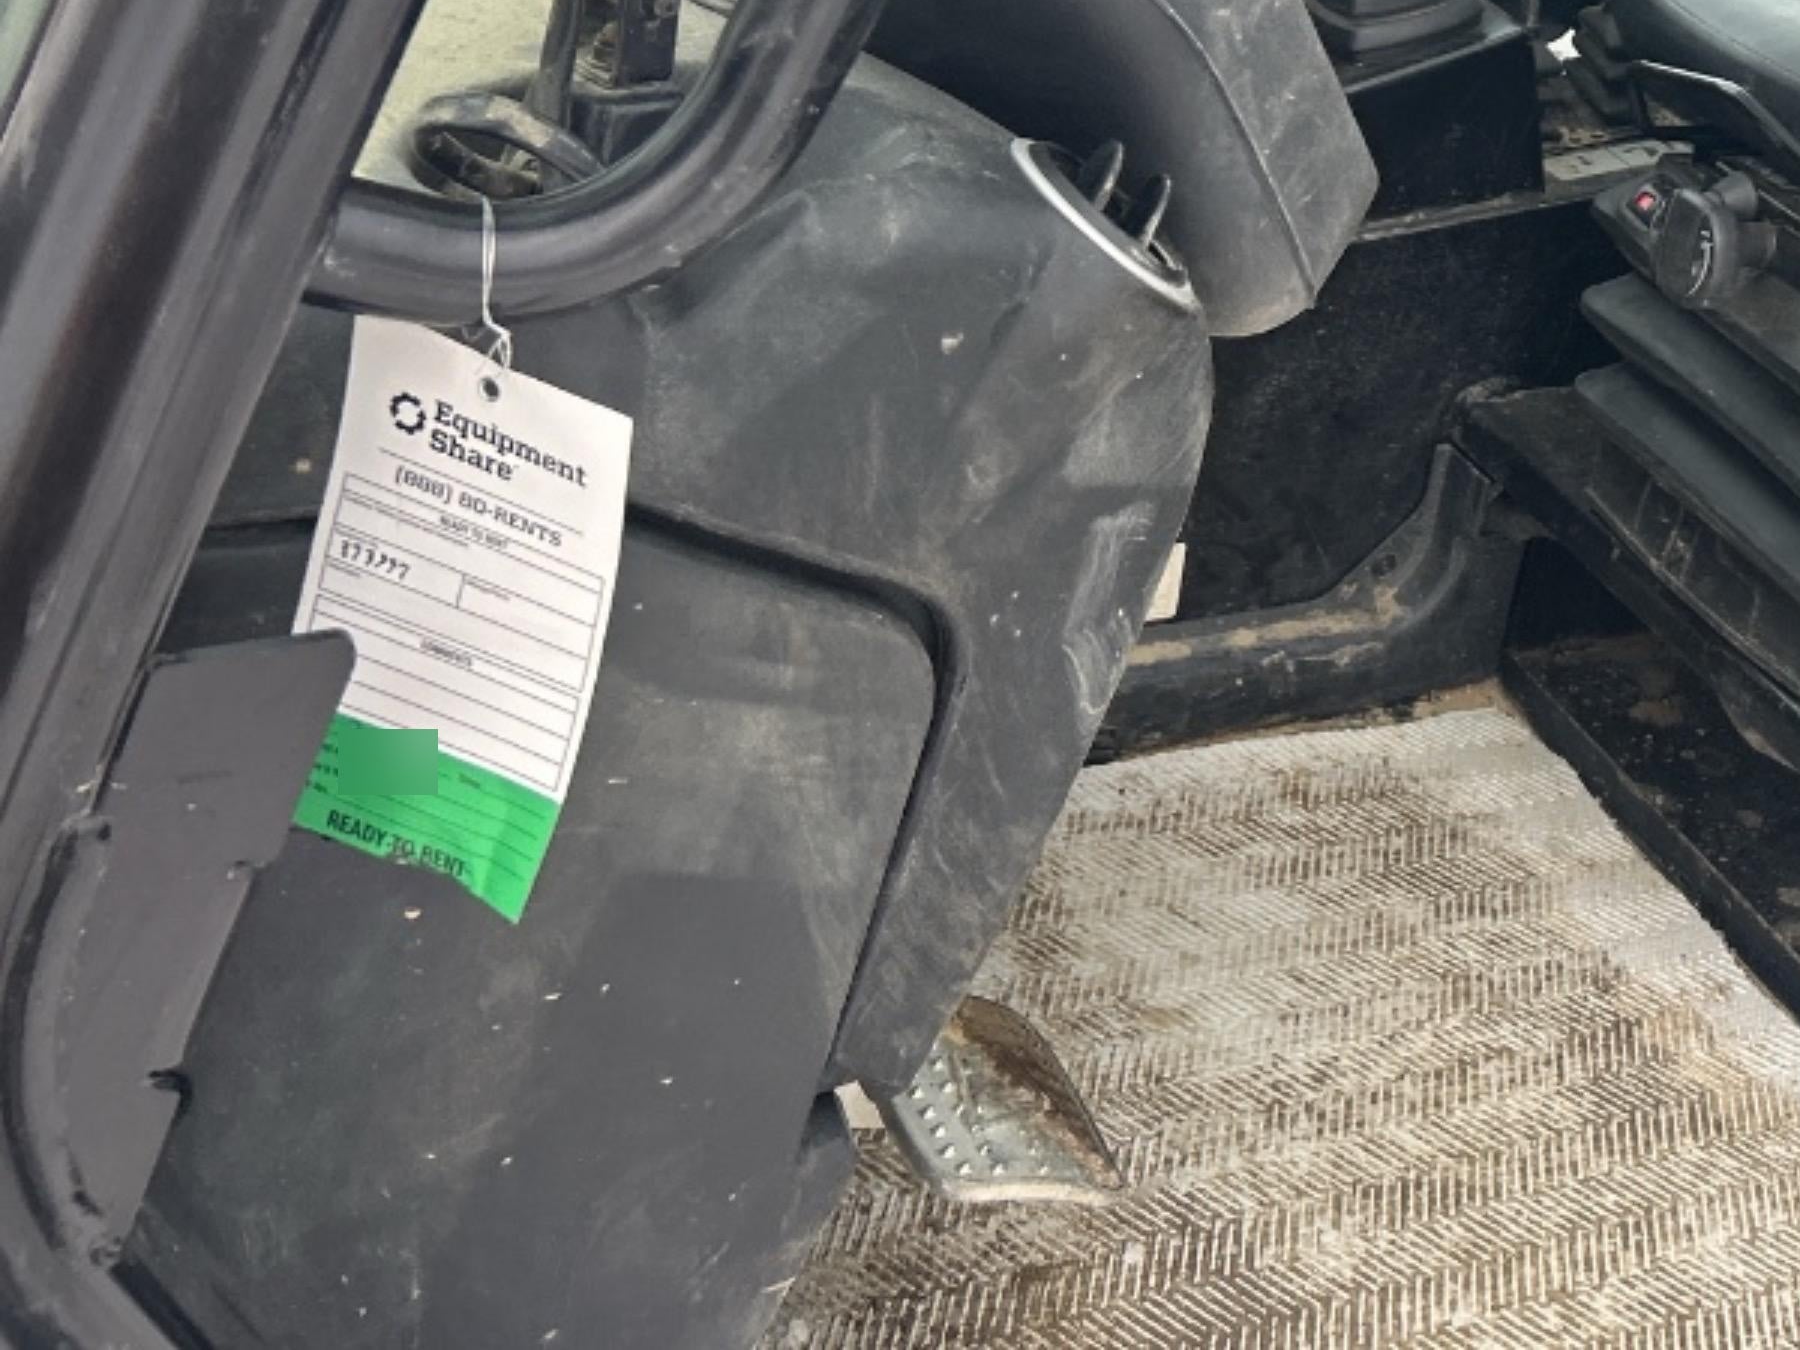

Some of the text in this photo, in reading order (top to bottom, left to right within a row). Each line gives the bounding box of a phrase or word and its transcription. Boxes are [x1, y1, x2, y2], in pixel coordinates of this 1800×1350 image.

[429, 427, 513, 482] Share
[433, 398, 589, 489] Equipment
[326, 809, 468, 878] READY TO RENT
